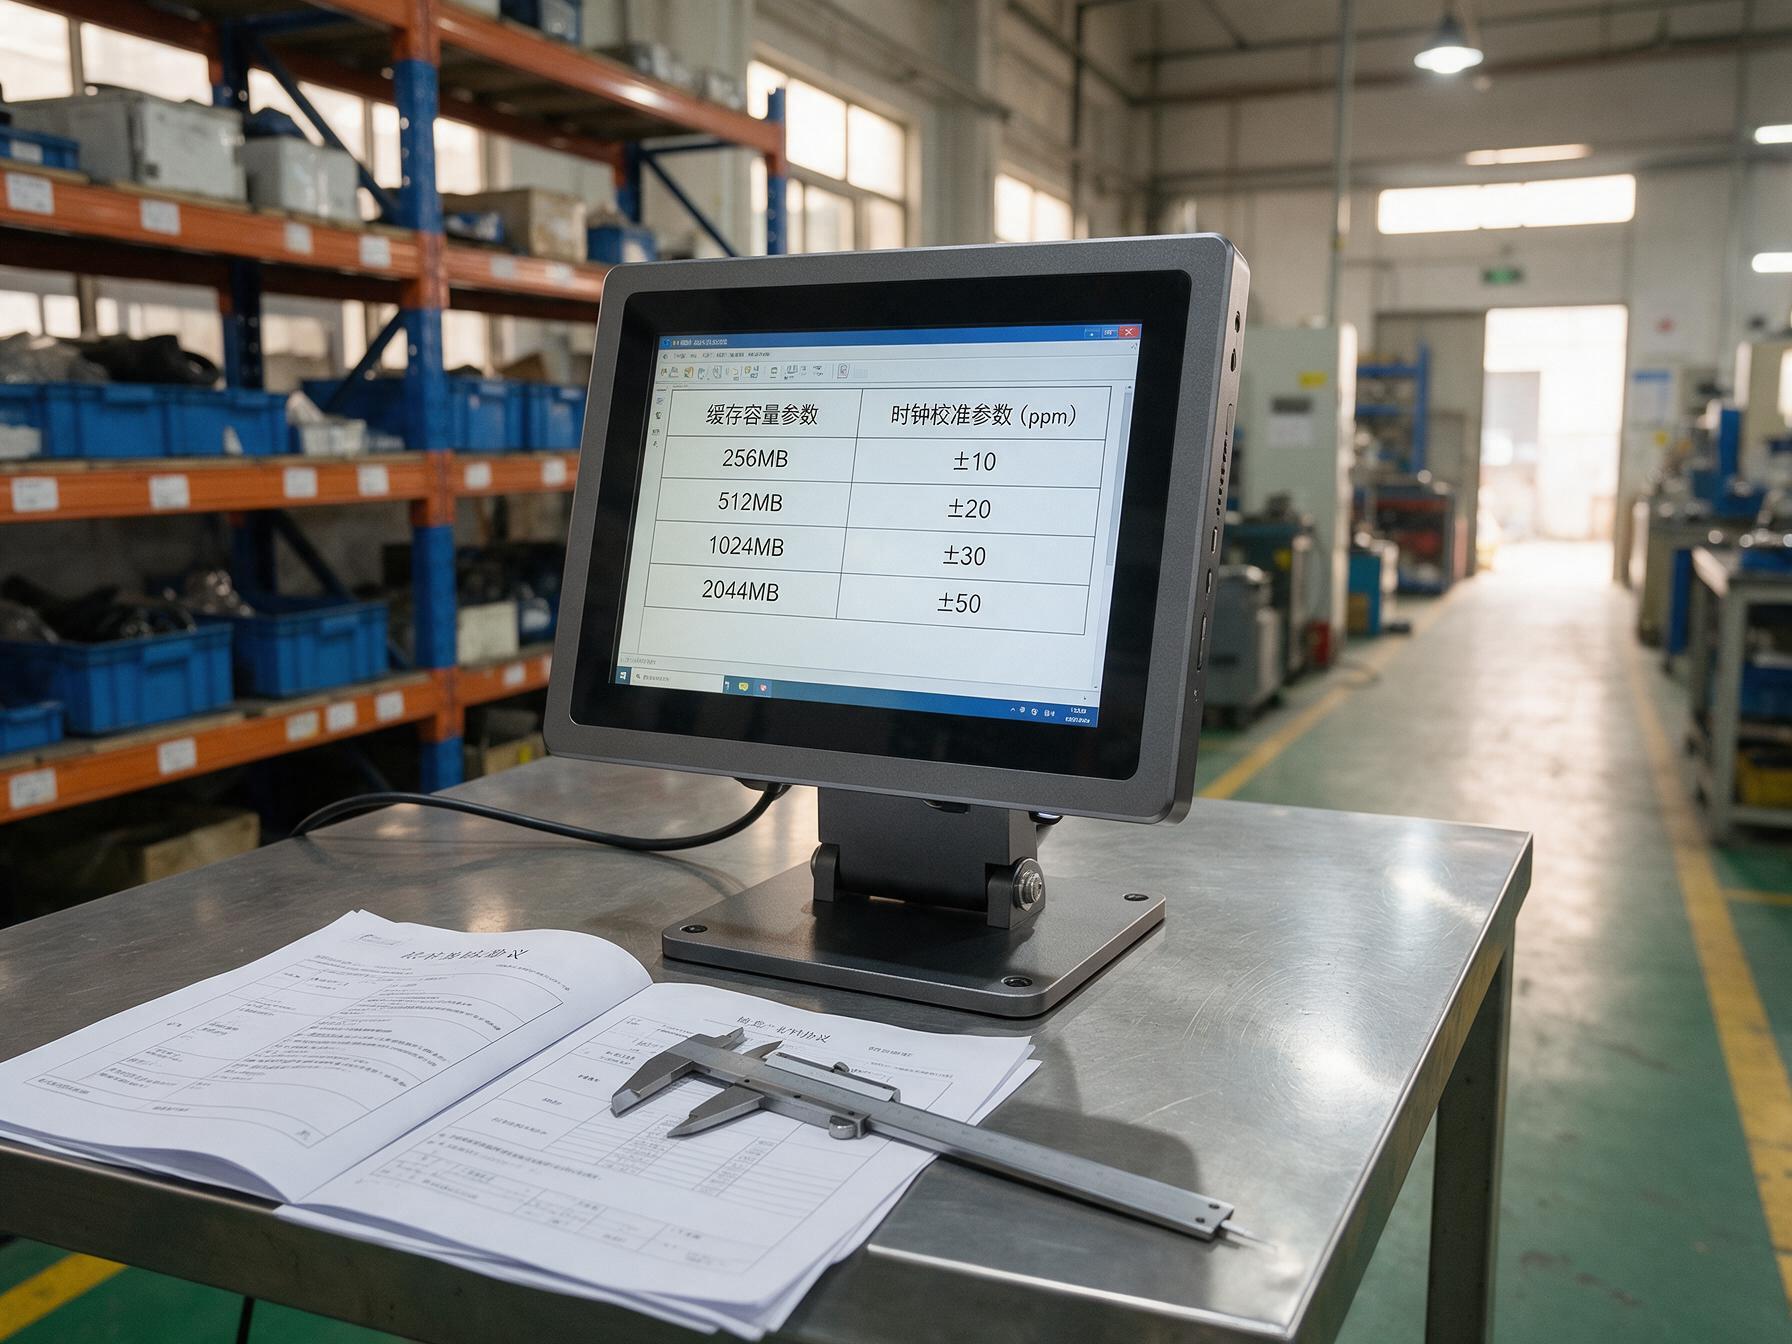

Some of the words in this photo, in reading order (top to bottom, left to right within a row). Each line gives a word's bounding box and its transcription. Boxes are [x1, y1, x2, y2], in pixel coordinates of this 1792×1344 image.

[705, 403, 819, 427] 缓存容量参数
[722, 448, 788, 468] 256MB
[953, 450, 997, 472] ±10
[717, 491, 783, 512] 512MB
[947, 497, 991, 520] ±20
[709, 535, 784, 557] 1024MB
[942, 544, 986, 567] ±30
[701, 579, 779, 602] 2044MB
[936, 591, 981, 614] ±50
